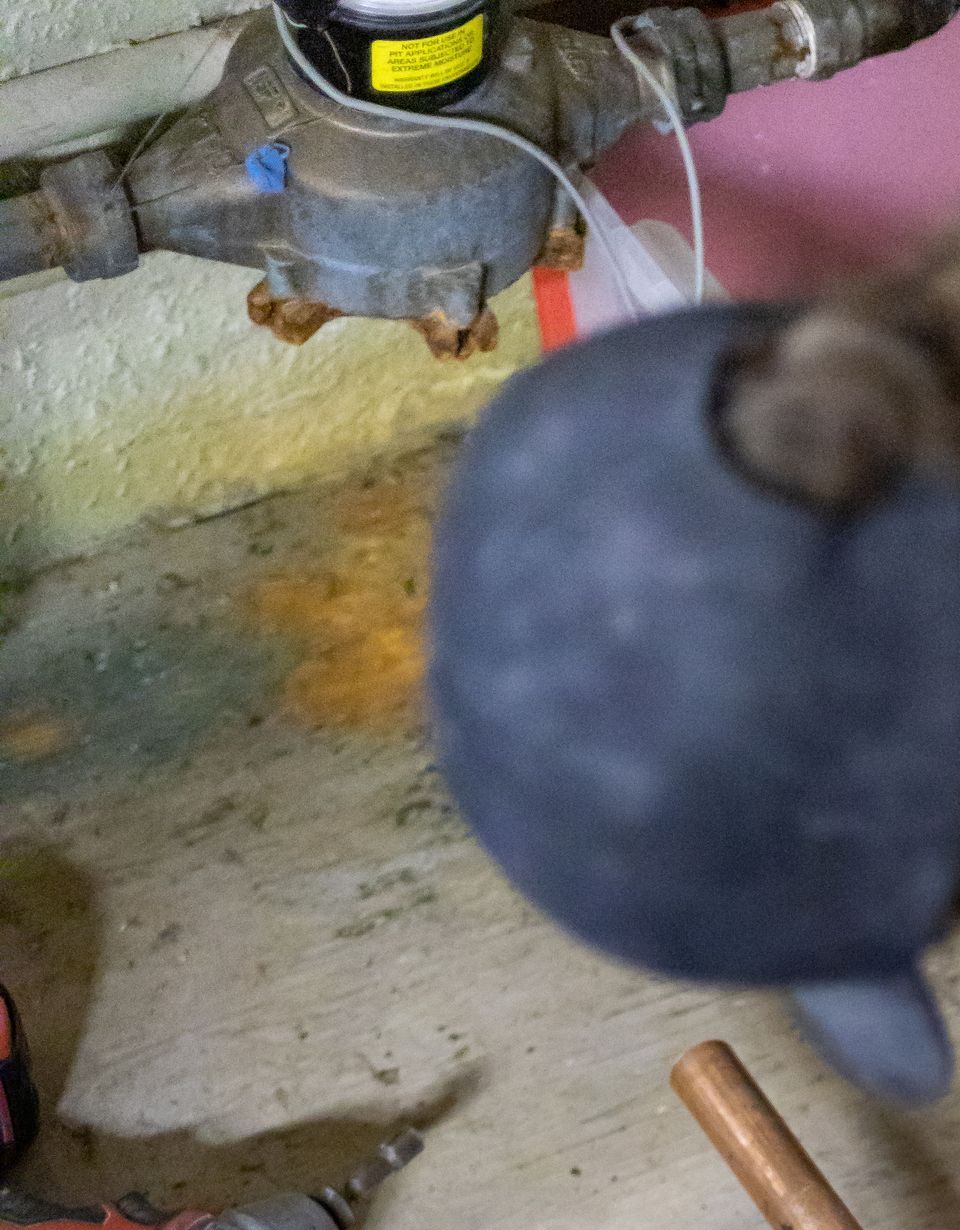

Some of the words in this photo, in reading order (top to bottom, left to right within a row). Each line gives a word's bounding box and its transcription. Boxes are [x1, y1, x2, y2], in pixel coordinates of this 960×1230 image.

[401, 42, 420, 51] NOT
[421, 38, 440, 48] FOR
[389, 50, 405, 58] PIT
[387, 57, 417, 65] AREAS
[391, 62, 433, 73] EXTREME
